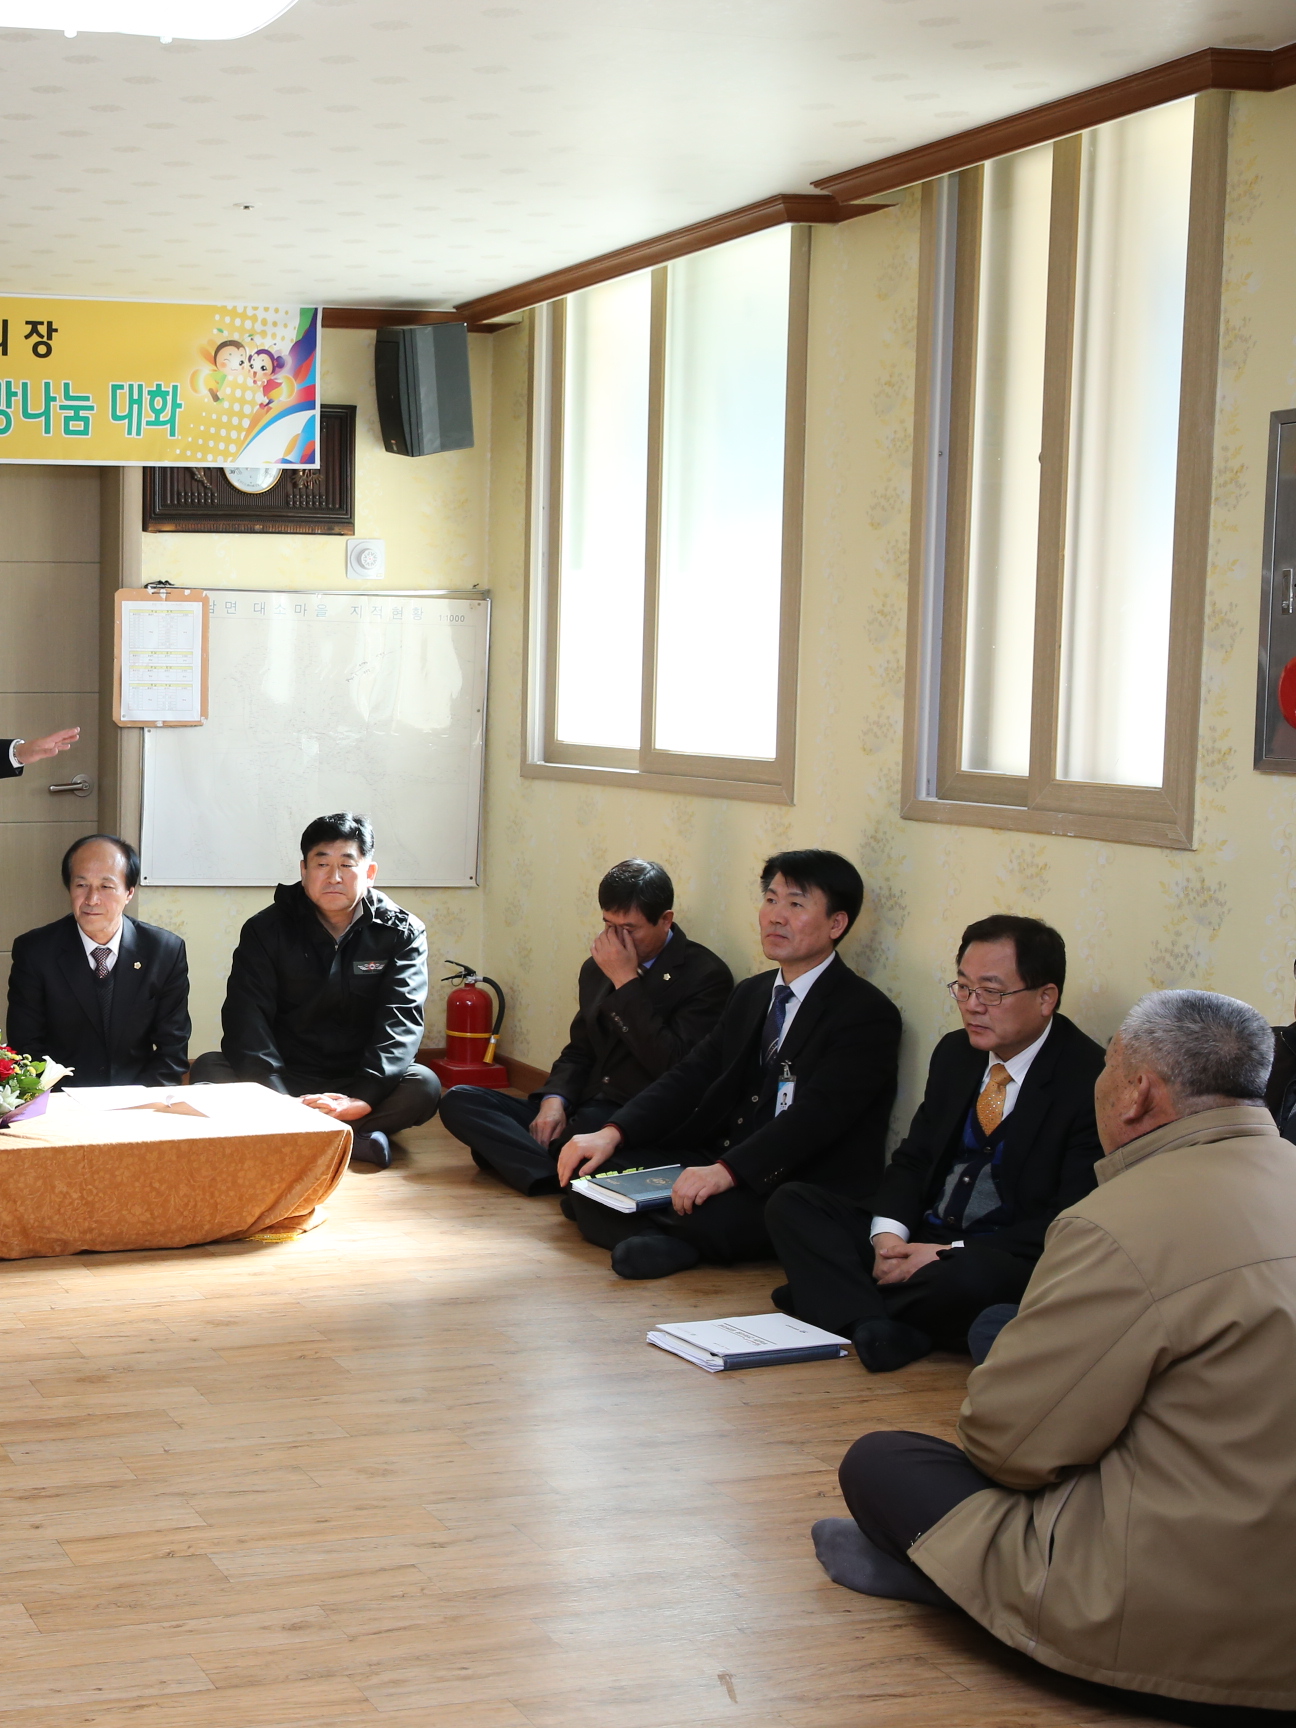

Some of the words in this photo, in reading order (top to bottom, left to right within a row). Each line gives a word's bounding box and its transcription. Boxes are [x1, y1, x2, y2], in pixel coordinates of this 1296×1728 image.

[24, 320, 59, 359] 장
[110, 382, 184, 438] 대화
[439, 614, 466, 623] 1:1000
